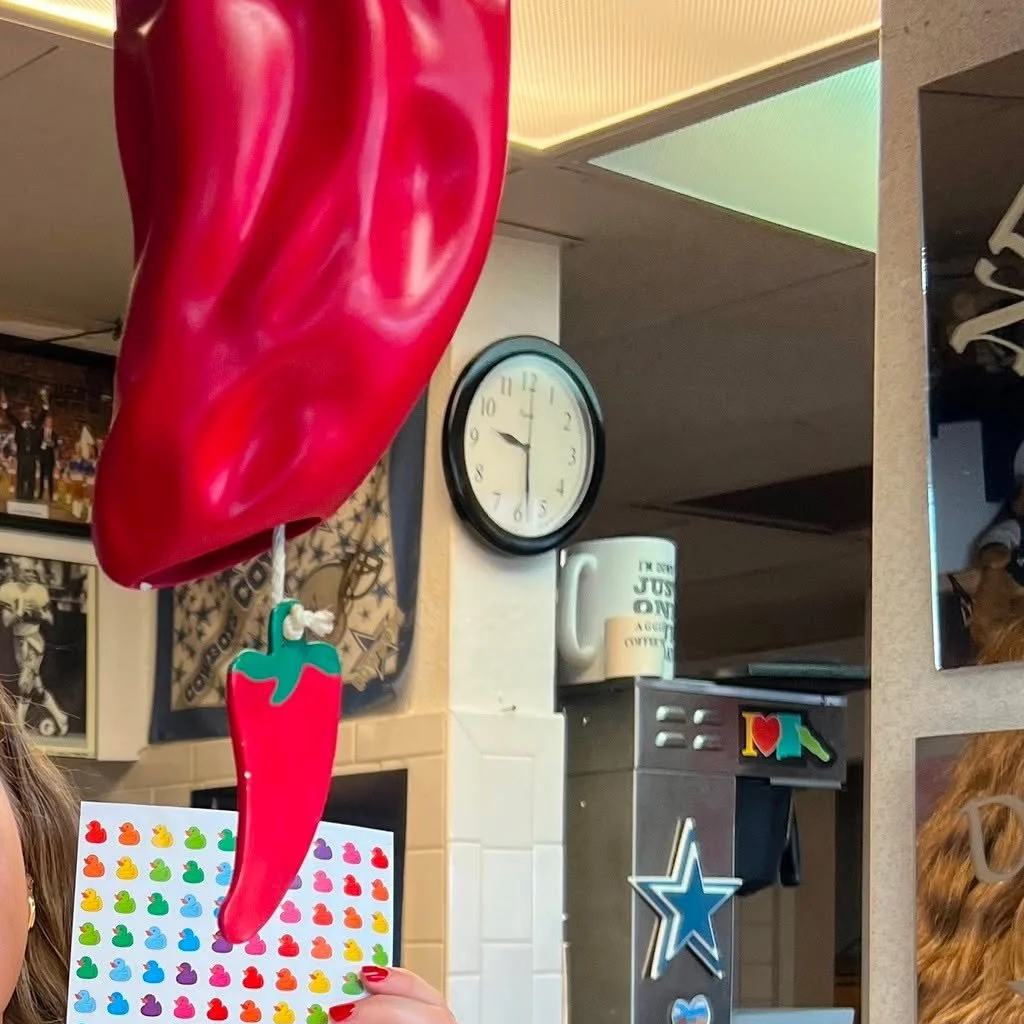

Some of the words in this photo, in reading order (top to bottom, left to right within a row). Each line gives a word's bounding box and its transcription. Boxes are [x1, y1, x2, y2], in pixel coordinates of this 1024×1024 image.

[501, 376, 513, 397] 11
[521, 371, 538, 392] 12
[481, 397, 496, 417] 10
[563, 411, 572, 431] 2
[469, 427, 480, 445] 9
[568, 446, 577, 467] 3
[475, 463, 484, 482] 8
[492, 491, 502, 511] 7
[514, 502, 523, 522] 6
